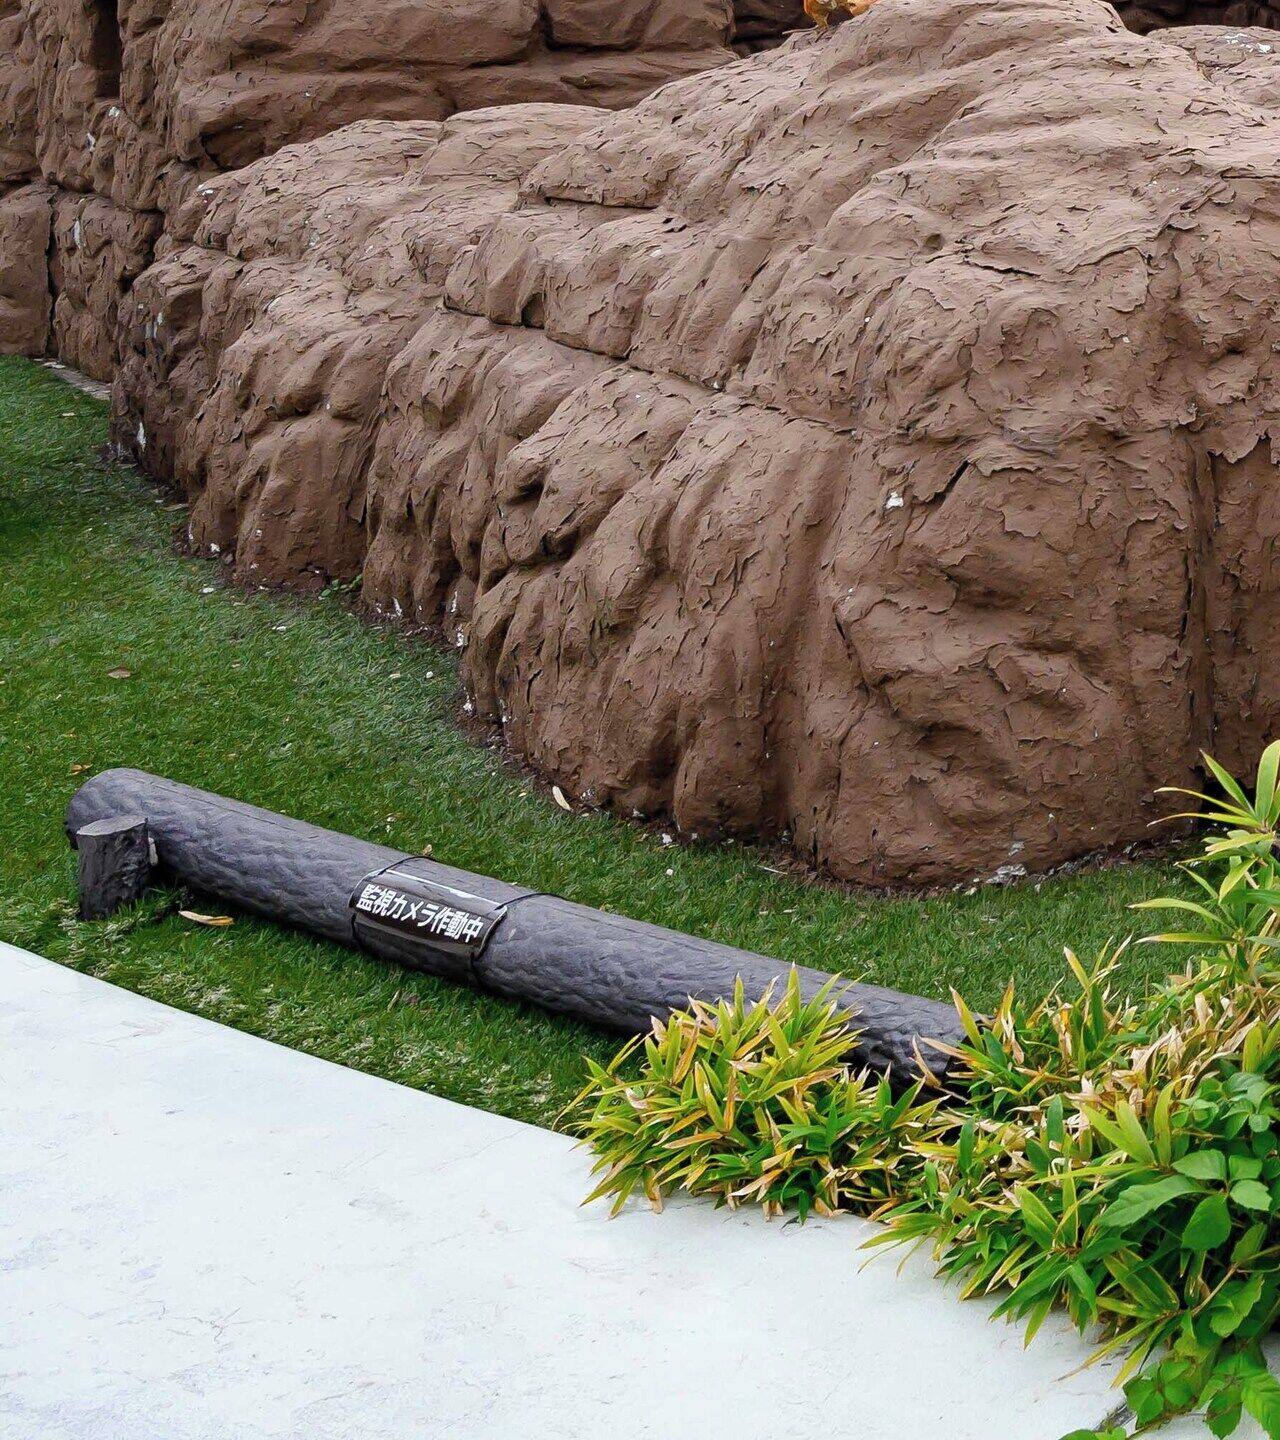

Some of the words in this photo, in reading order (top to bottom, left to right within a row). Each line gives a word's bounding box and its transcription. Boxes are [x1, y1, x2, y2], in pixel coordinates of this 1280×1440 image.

[356, 883, 484, 944] 監視カメラ作動中
